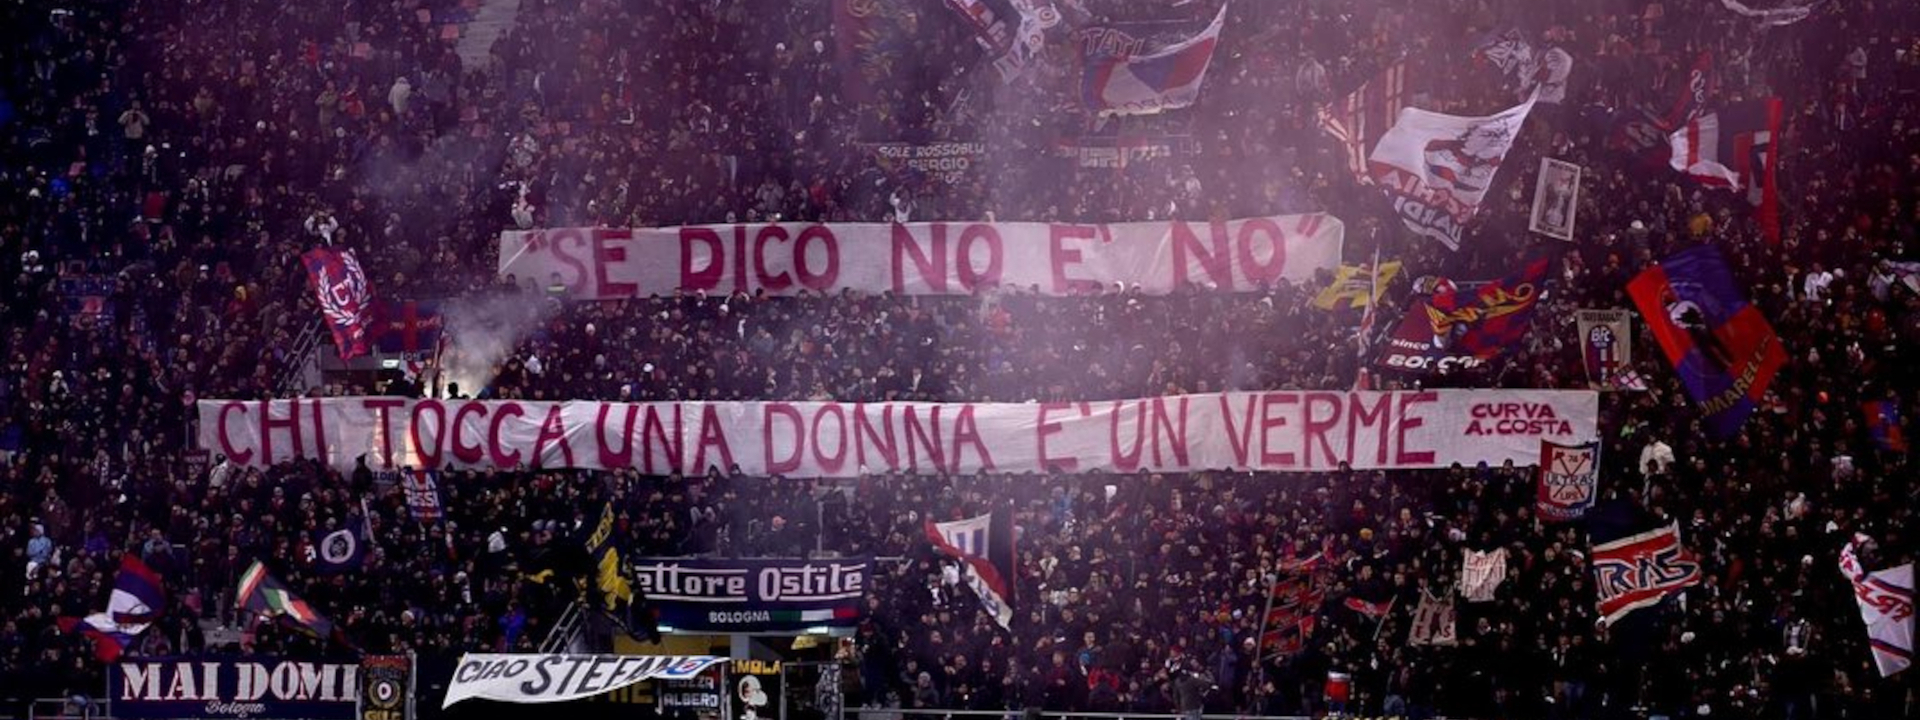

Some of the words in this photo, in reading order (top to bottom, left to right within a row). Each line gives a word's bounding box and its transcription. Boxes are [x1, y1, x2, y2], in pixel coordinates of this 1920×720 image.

[879, 146, 911, 158] SOLE
[916, 143, 984, 157] ROSSOBLU
[679, 224, 840, 292] DICO
[890, 221, 1004, 293] NO
[1049, 223, 1112, 292] E'
[1469, 402, 1556, 419] CURVA
[217, 399, 329, 466] CHI
[363, 399, 574, 469] TOCCA
[595, 402, 735, 473] UNA
[763, 401, 997, 474] DONNA
[1220, 392, 1439, 468] VERME
[1546, 473, 1594, 487] ULTRAS
[758, 562, 866, 601] Ostile
[708, 610, 771, 624] BOLOGNA
[120, 661, 221, 701] MAI
[234, 661, 359, 701] DOMI
[456, 659, 529, 684] CIAO
[204, 700, 266, 718] Bologna
